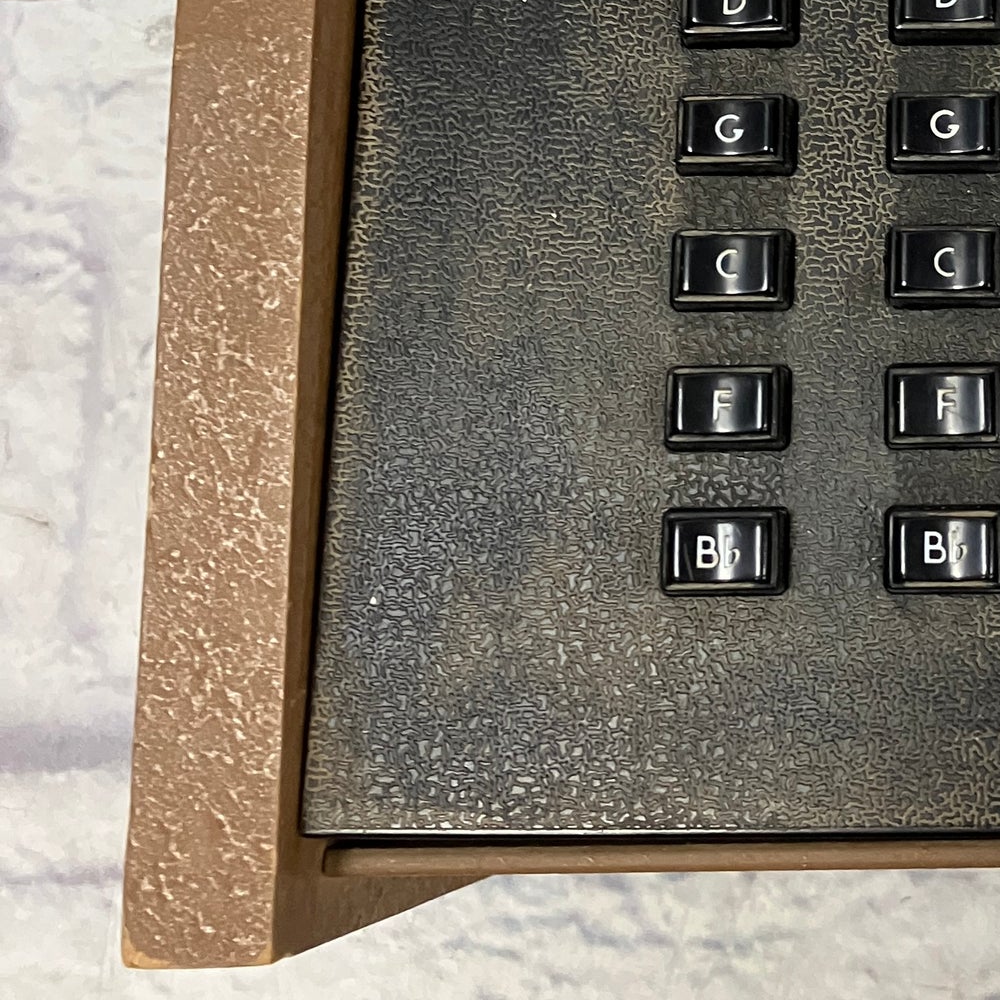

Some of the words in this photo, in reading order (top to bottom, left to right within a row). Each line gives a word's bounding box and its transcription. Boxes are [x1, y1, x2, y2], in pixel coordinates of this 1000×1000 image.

[715, 114, 744, 143] G
[930, 109, 959, 139] G
[716, 249, 738, 278] C
[934, 247, 955, 277] C
[713, 390, 732, 421] F
[936, 389, 956, 420] F
